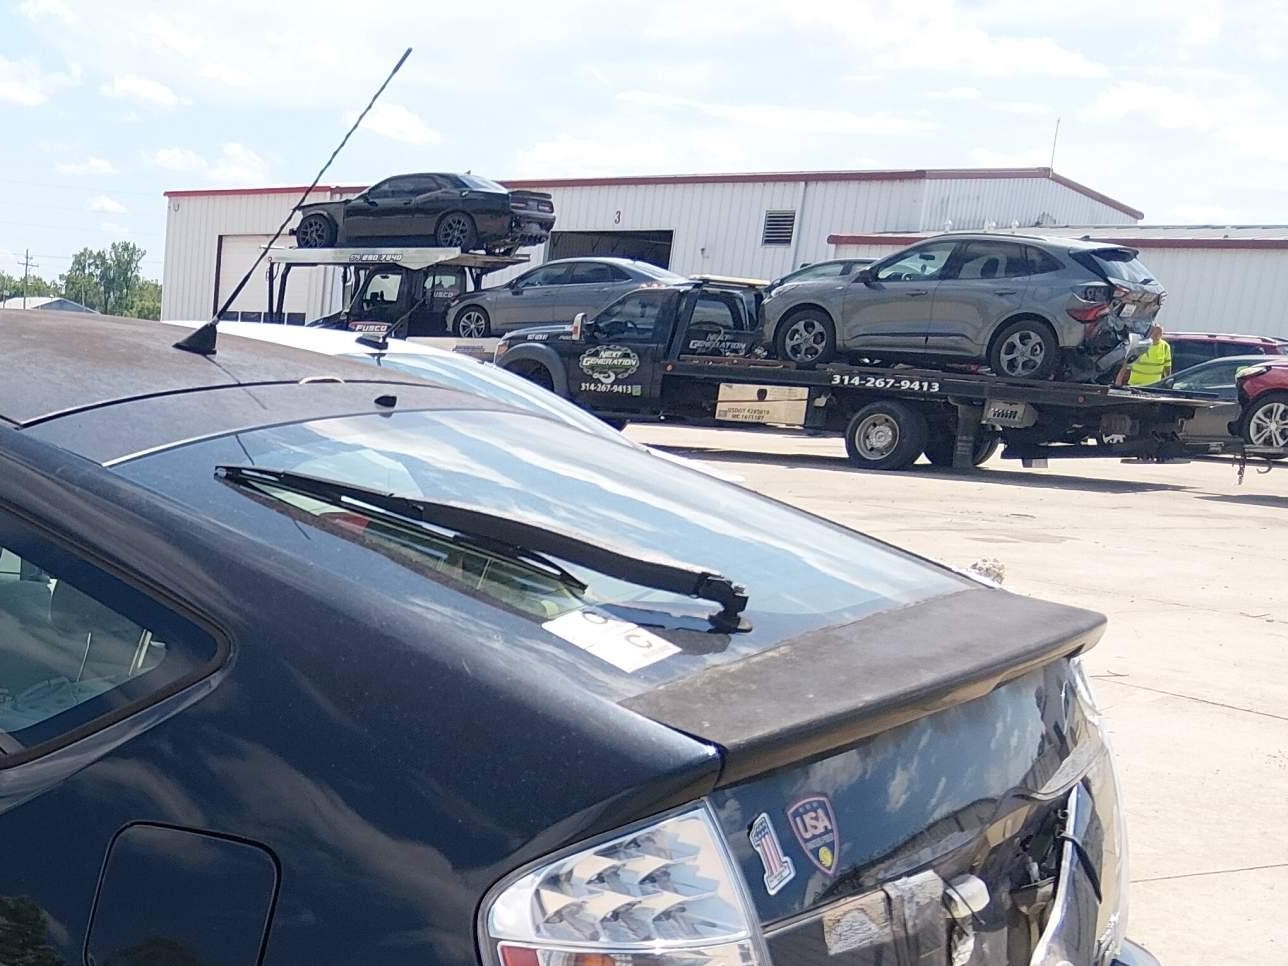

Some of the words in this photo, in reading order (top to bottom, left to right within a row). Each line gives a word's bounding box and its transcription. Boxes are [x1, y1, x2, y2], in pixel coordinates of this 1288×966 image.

[614, 210, 621, 225] 3
[599, 350, 623, 358] NEXT
[582, 358, 637, 366] GENERATION
[580, 382, 632, 394] 314-267-9413
[831, 374, 940, 393] 314-267-9413
[795, 807, 833, 840] USA
